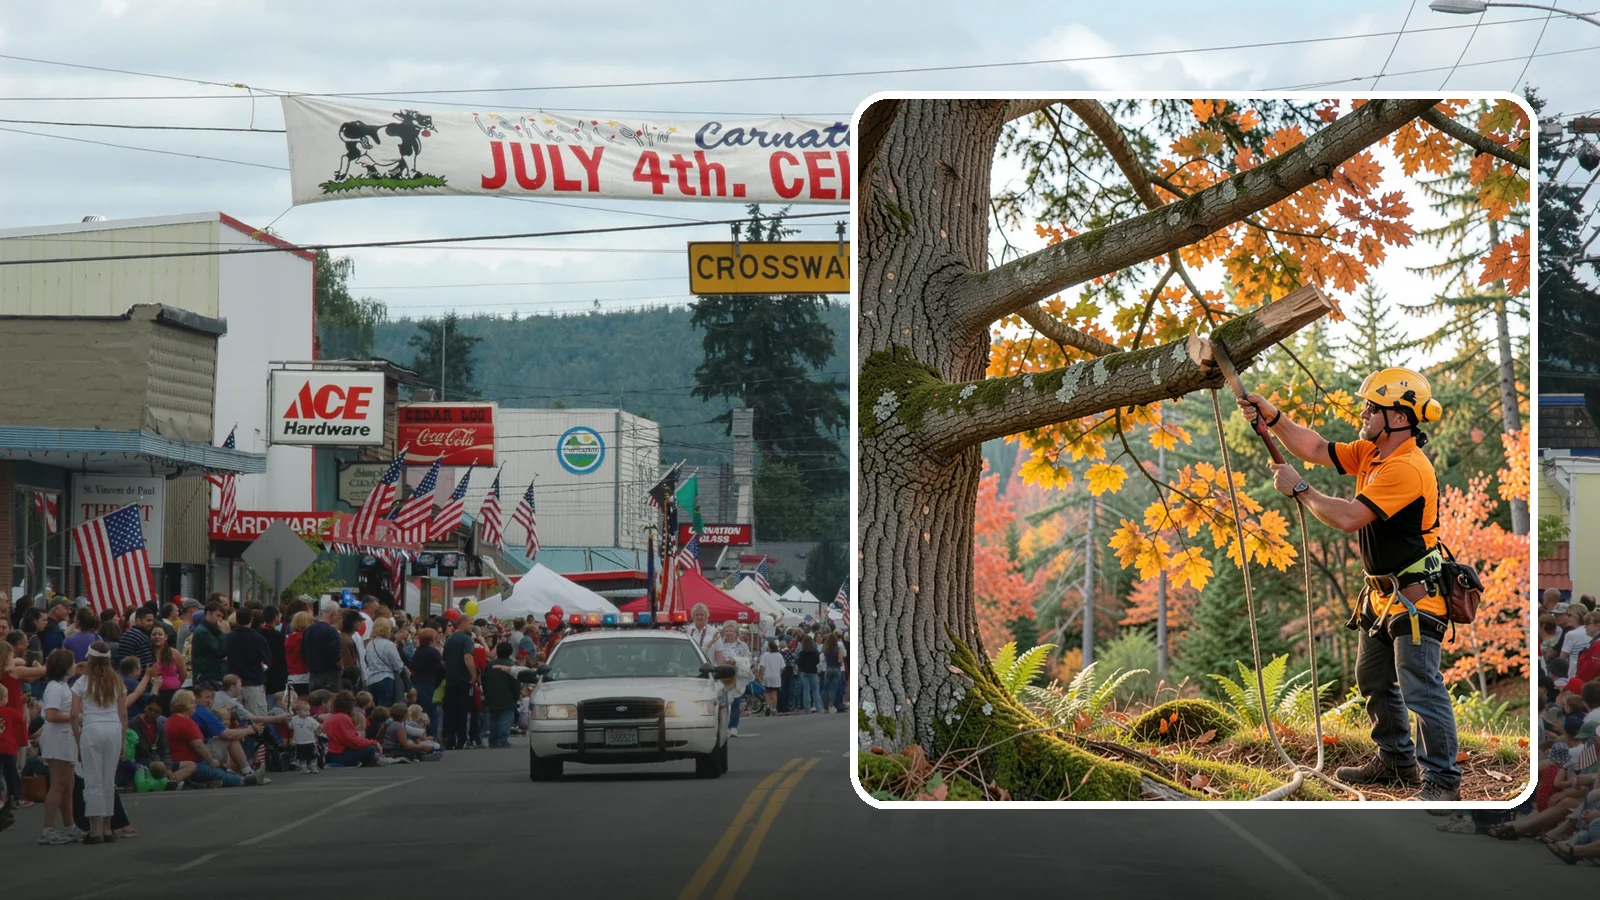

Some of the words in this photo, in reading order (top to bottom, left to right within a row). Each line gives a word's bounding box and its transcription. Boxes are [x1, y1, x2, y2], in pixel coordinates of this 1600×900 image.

[694, 121, 850, 150] Carnat
[481, 140, 605, 193] JULY
[632, 149, 746, 198] 4th.
[696, 254, 850, 280] CROSSWA
[282, 380, 373, 420] ACE
[405, 409, 452, 422] CEDAR
[283, 421, 370, 437] Hardware
[416, 428, 477, 447] Coca-Cola
[95, 485, 124, 495] Vincent
[126, 486, 136, 495] de
[138, 486, 155, 495] Paul
[212, 516, 331, 536] HARDARE
[688, 526, 741, 535] CRNATION
[699, 535, 730, 544] GLASS
